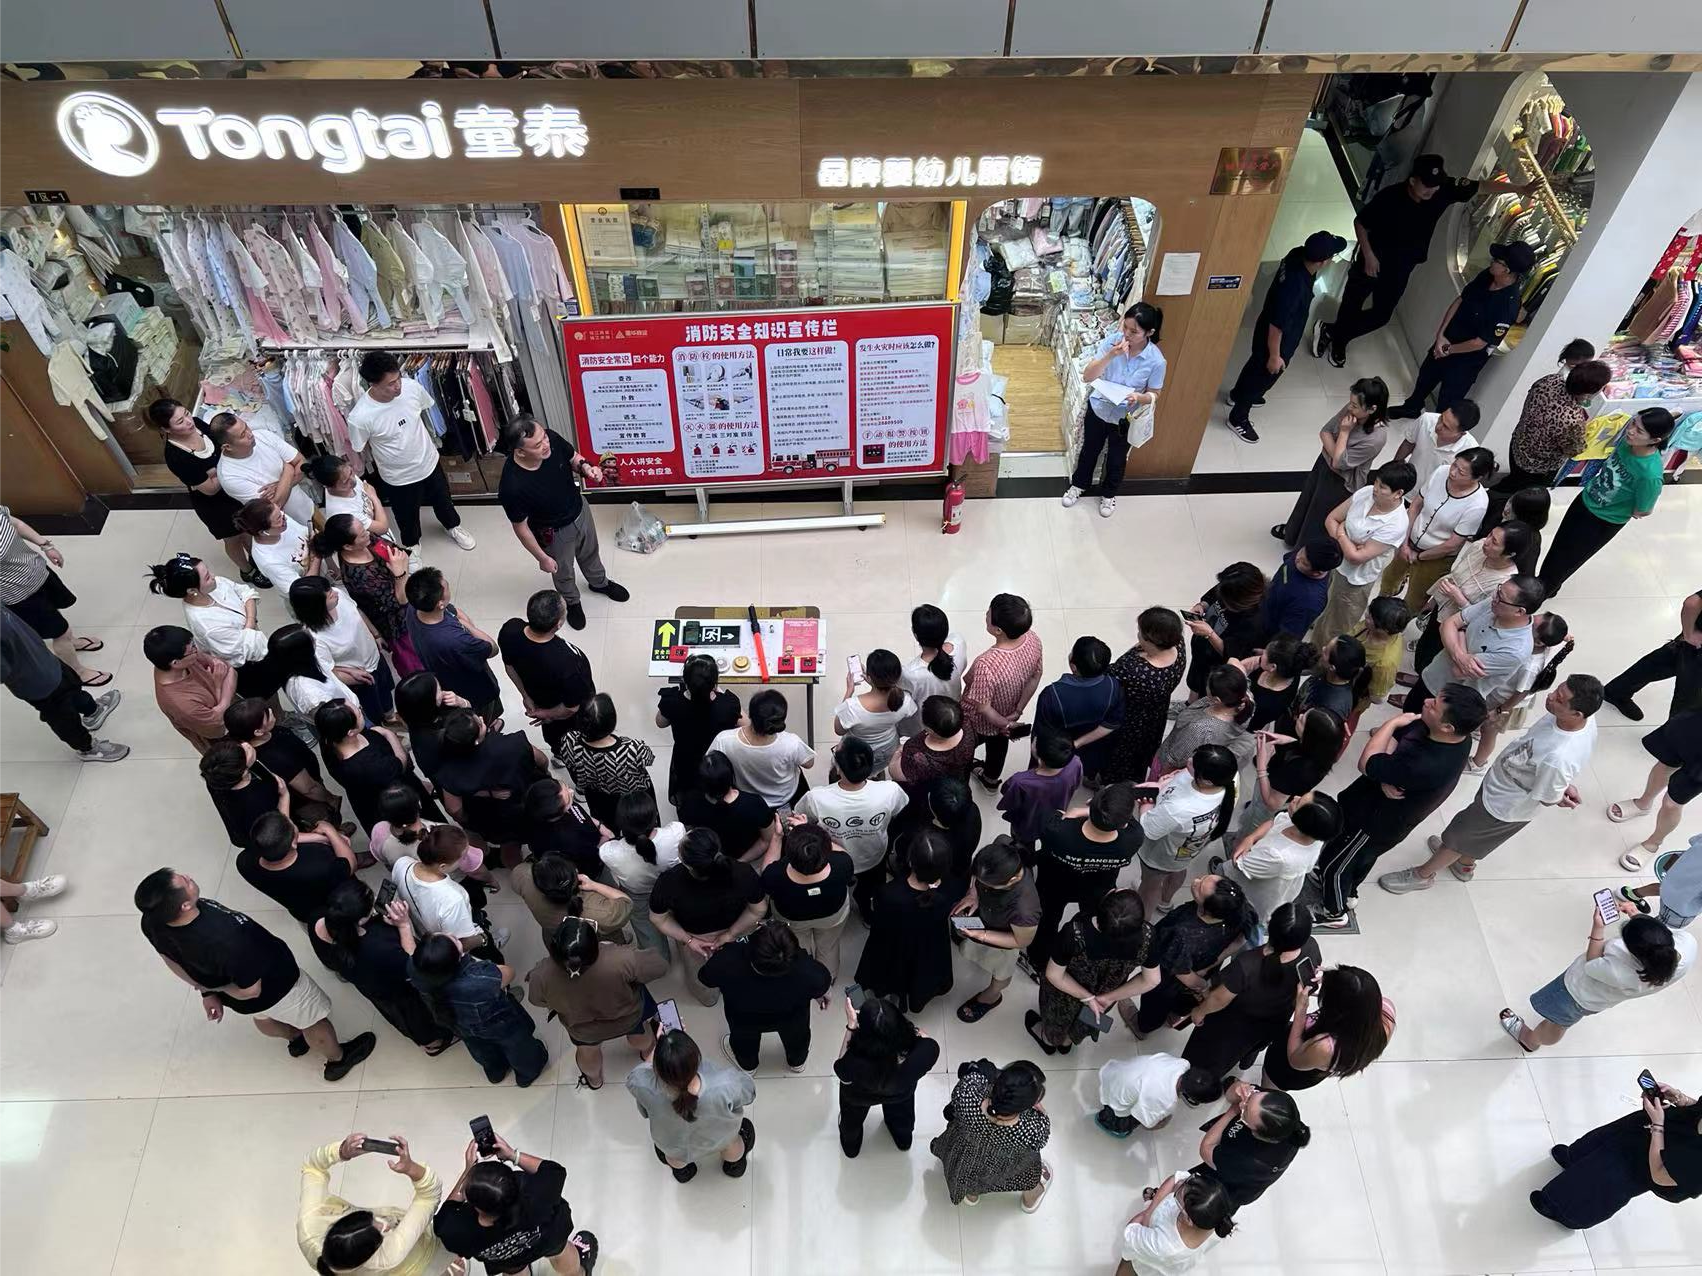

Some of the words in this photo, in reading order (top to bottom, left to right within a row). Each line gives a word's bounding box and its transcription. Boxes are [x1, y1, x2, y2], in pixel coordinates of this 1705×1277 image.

[156, 101, 452, 173] Tongtai
[454, 104, 589, 158] 童泰
[818, 156, 1043, 188] 品牌婴幼儿服饰
[30, 192, 65, 202] 7区-1
[685, 319, 838, 342] 消防安全知识宣传栏
[777, 346, 836, 357] 日常我要这样做!
[860, 341, 935, 352] 发生火灾时应该怎么做?
[581, 355, 631, 365] 消防安全常识
[633, 354, 665, 363] 四个能力
[676, 351, 755, 362] 消防栓的使用方法
[683, 421, 759, 432] 灭火器的使用方法
[888, 439, 927, 448] 的使用方法
[620, 457, 662, 466] 人人讲安全
[630, 467, 673, 476] 个个会应急
